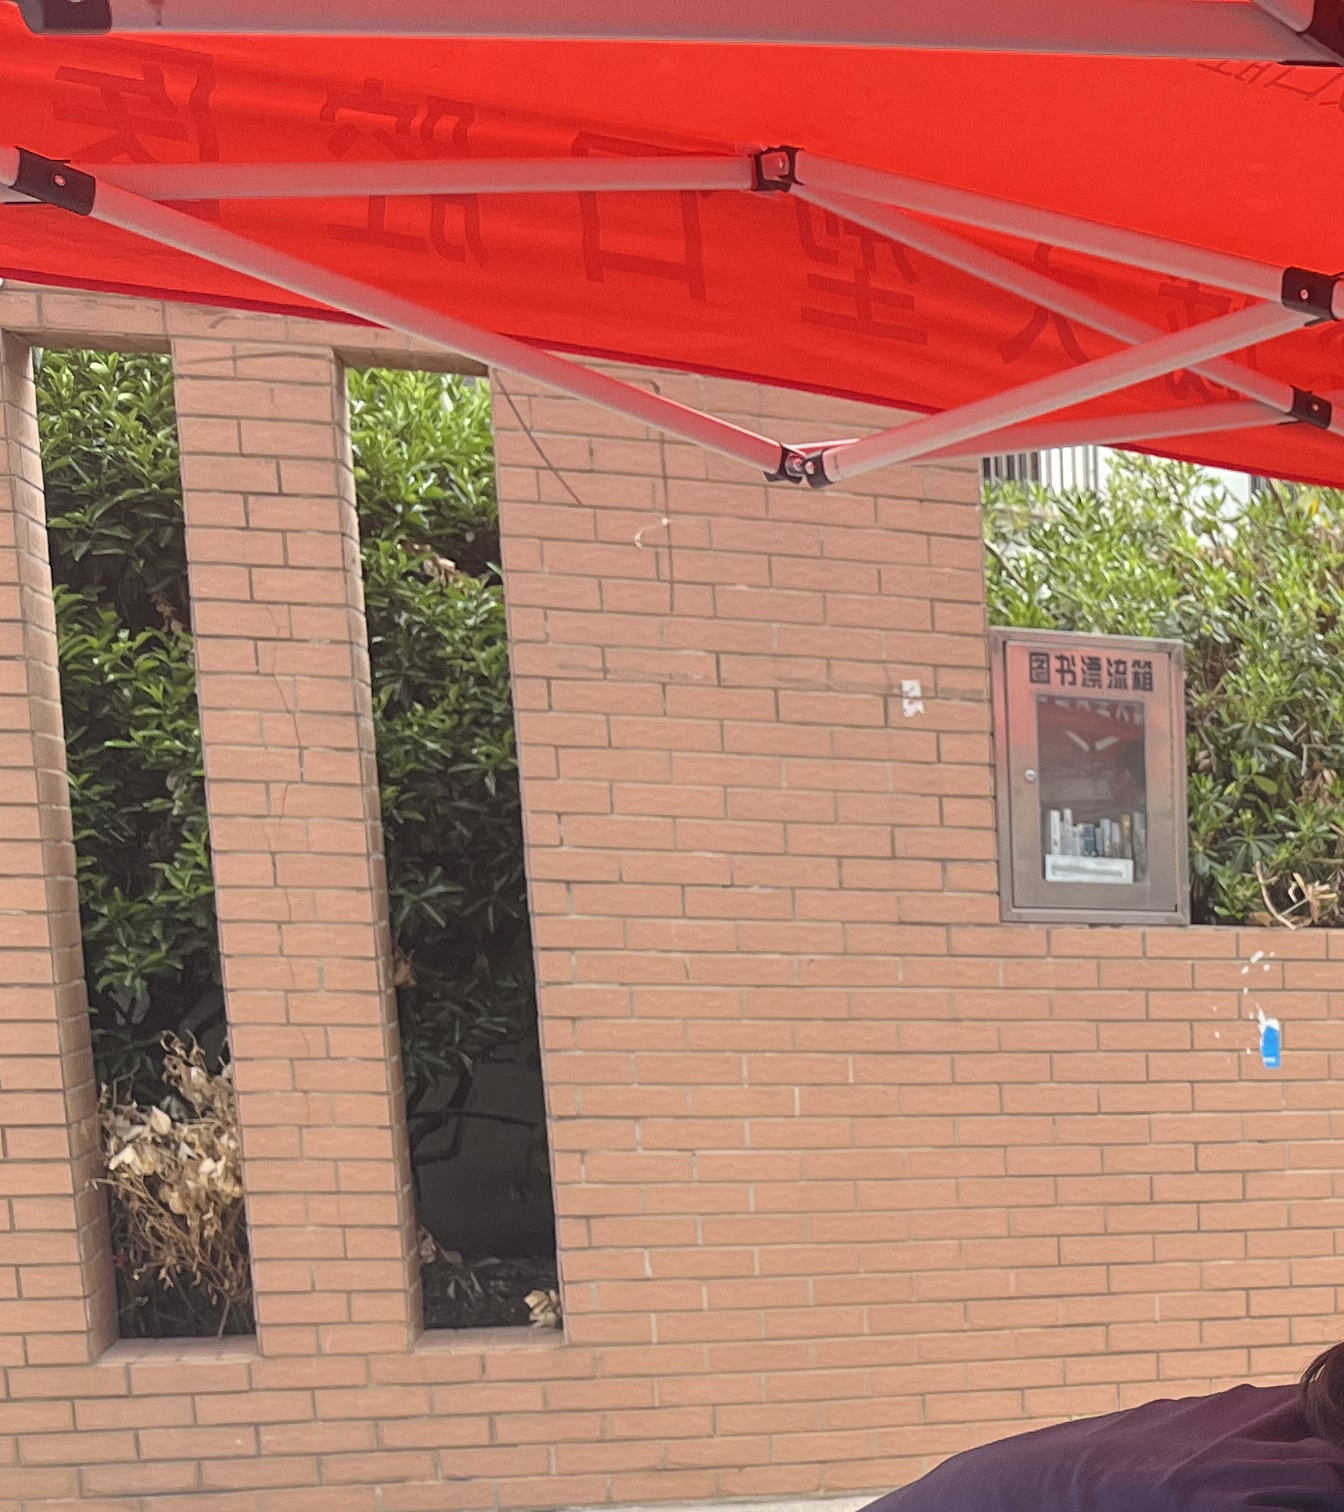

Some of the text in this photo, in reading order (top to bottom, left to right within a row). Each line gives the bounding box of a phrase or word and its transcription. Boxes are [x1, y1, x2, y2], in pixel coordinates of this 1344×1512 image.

[1028, 651, 1154, 692] 图书漂流箱
